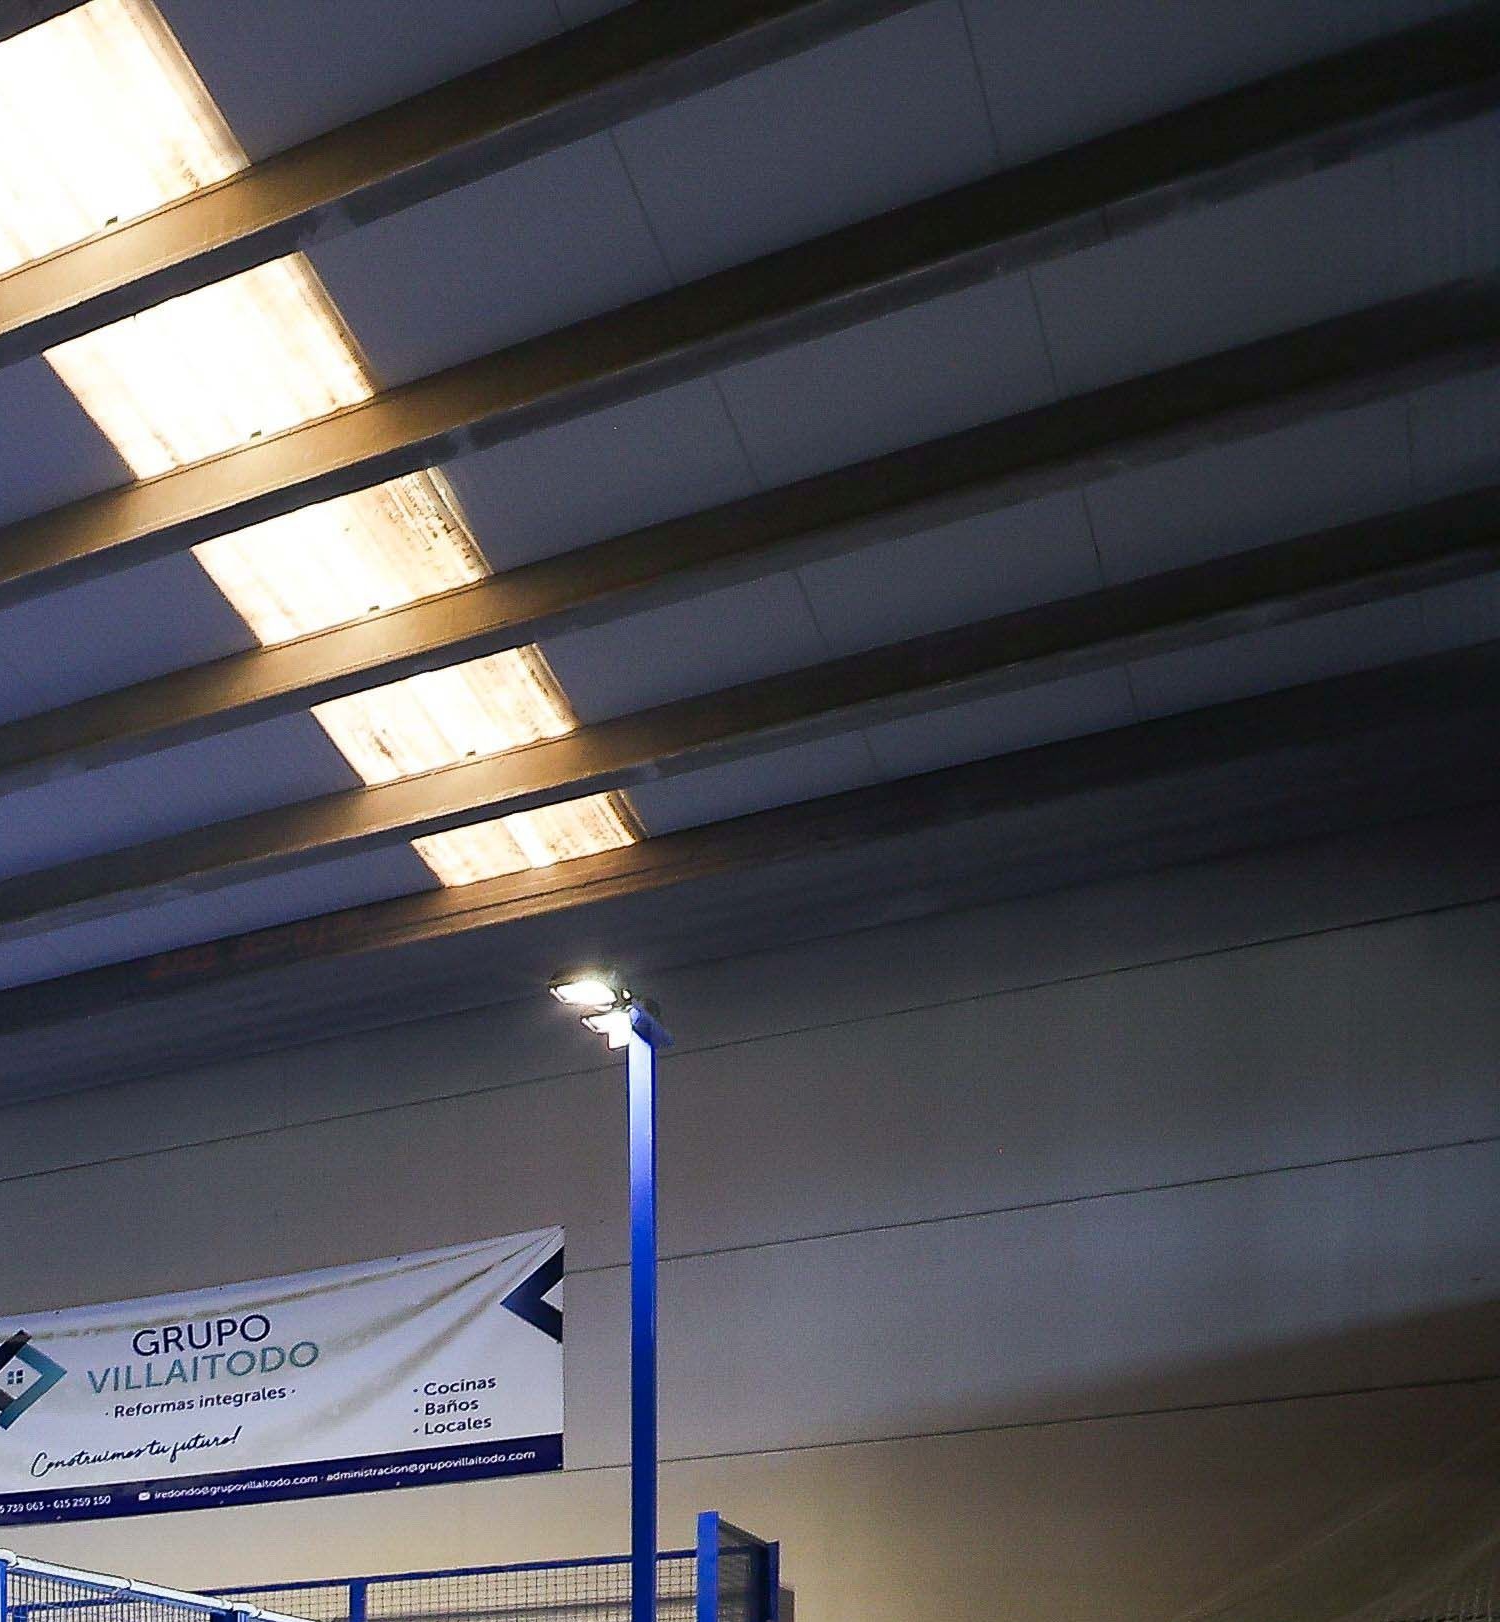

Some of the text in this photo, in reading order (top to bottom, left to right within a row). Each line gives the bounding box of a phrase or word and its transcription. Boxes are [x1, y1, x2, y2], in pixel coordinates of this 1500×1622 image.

[132, 1314, 271, 1357] GRUPO
[87, 1341, 319, 1394] VILLAITODO
[424, 1376, 497, 1396] Cocinas
[114, 1386, 286, 1418] Reformas integrales
[425, 1398, 479, 1416] Baños
[425, 1416, 492, 1435] Locales
